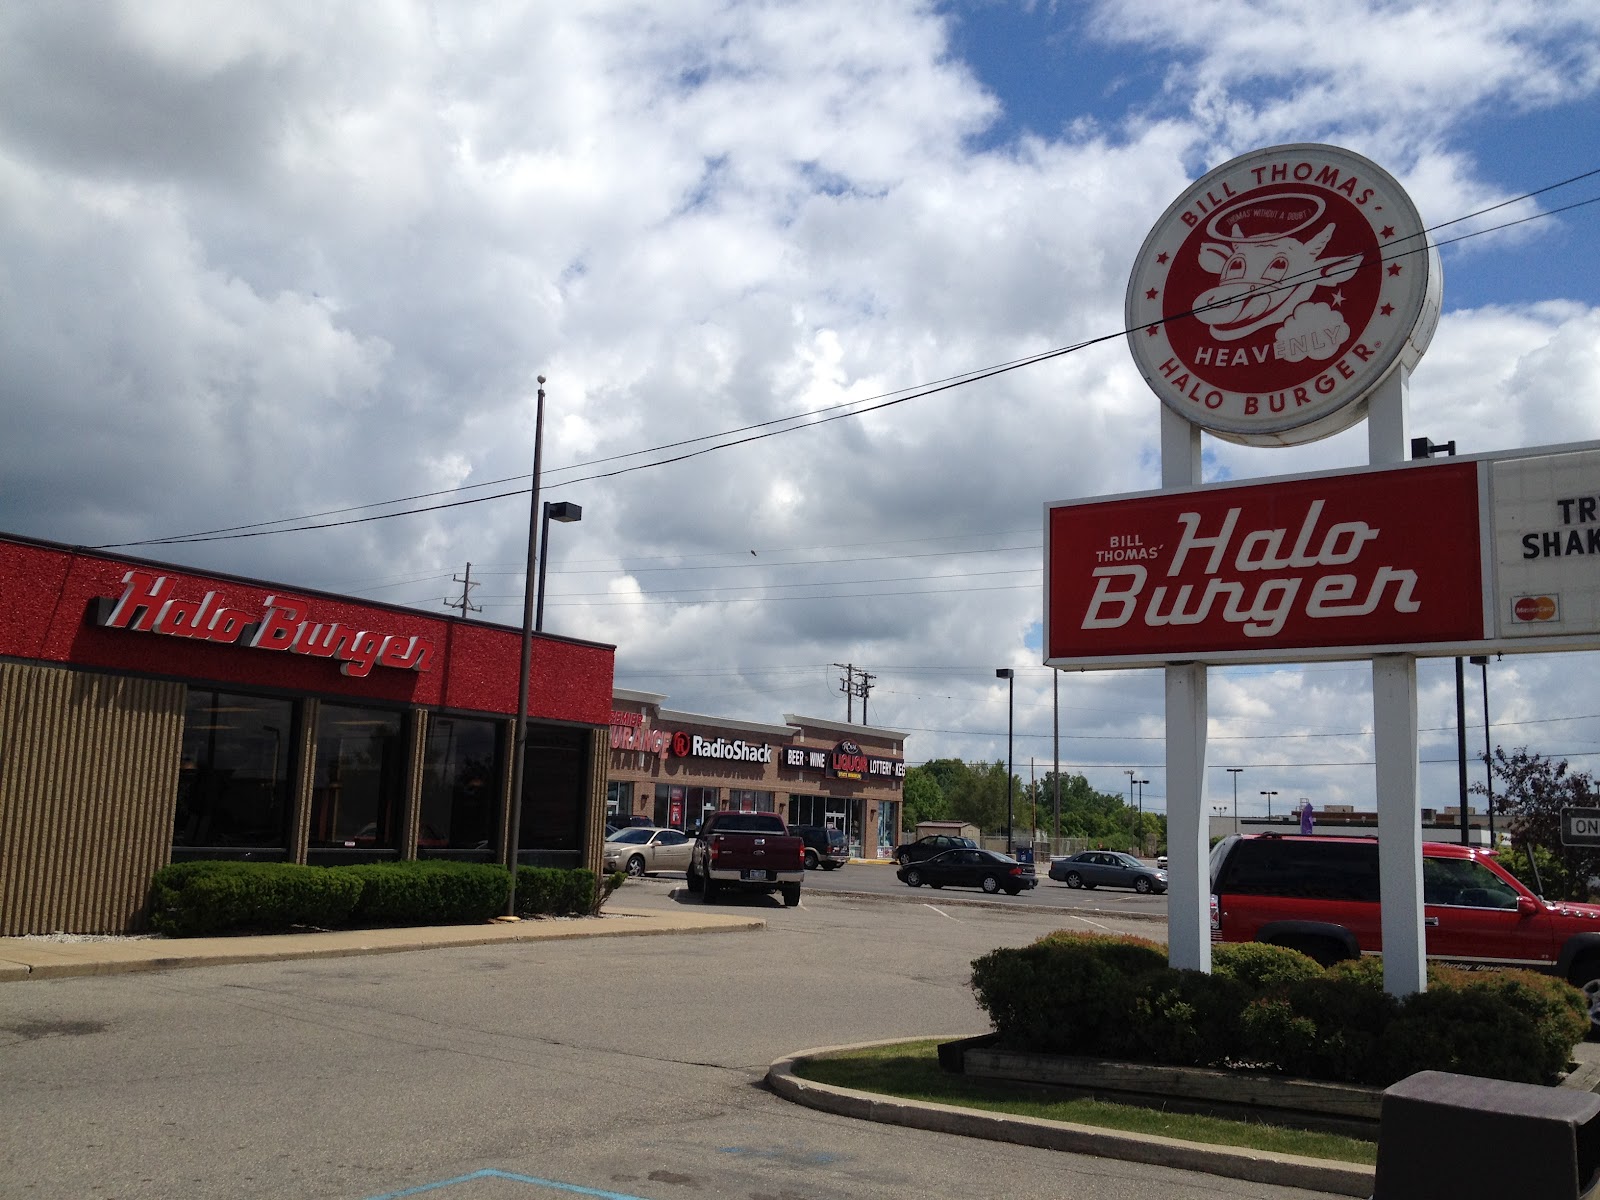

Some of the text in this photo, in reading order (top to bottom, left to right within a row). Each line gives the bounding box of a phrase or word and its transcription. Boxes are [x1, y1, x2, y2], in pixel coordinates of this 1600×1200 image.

[1181, 163, 1382, 228] BILL THOMAS'
[1253, 208, 1279, 219] WITHOUT
[1194, 325, 1341, 367] HEAVENLY
[1159, 343, 1375, 415] HALO BURGER
[1557, 496, 1600, 525] TR
[1110, 535, 1143, 548] BILL
[1167, 499, 1380, 577] Halo
[1096, 544, 1164, 563] THOMAS'
[1081, 566, 1421, 637] Burger
[105, 571, 435, 677] Halo Burger
[608, 710, 643, 728] REMIER
[610, 724, 672, 759] URANCE
[693, 735, 772, 763] RadioShack
[787, 749, 825, 768] BEER WINE
[832, 753, 868, 773] LIQUOR
[869, 759, 892, 776] LOTTERY
